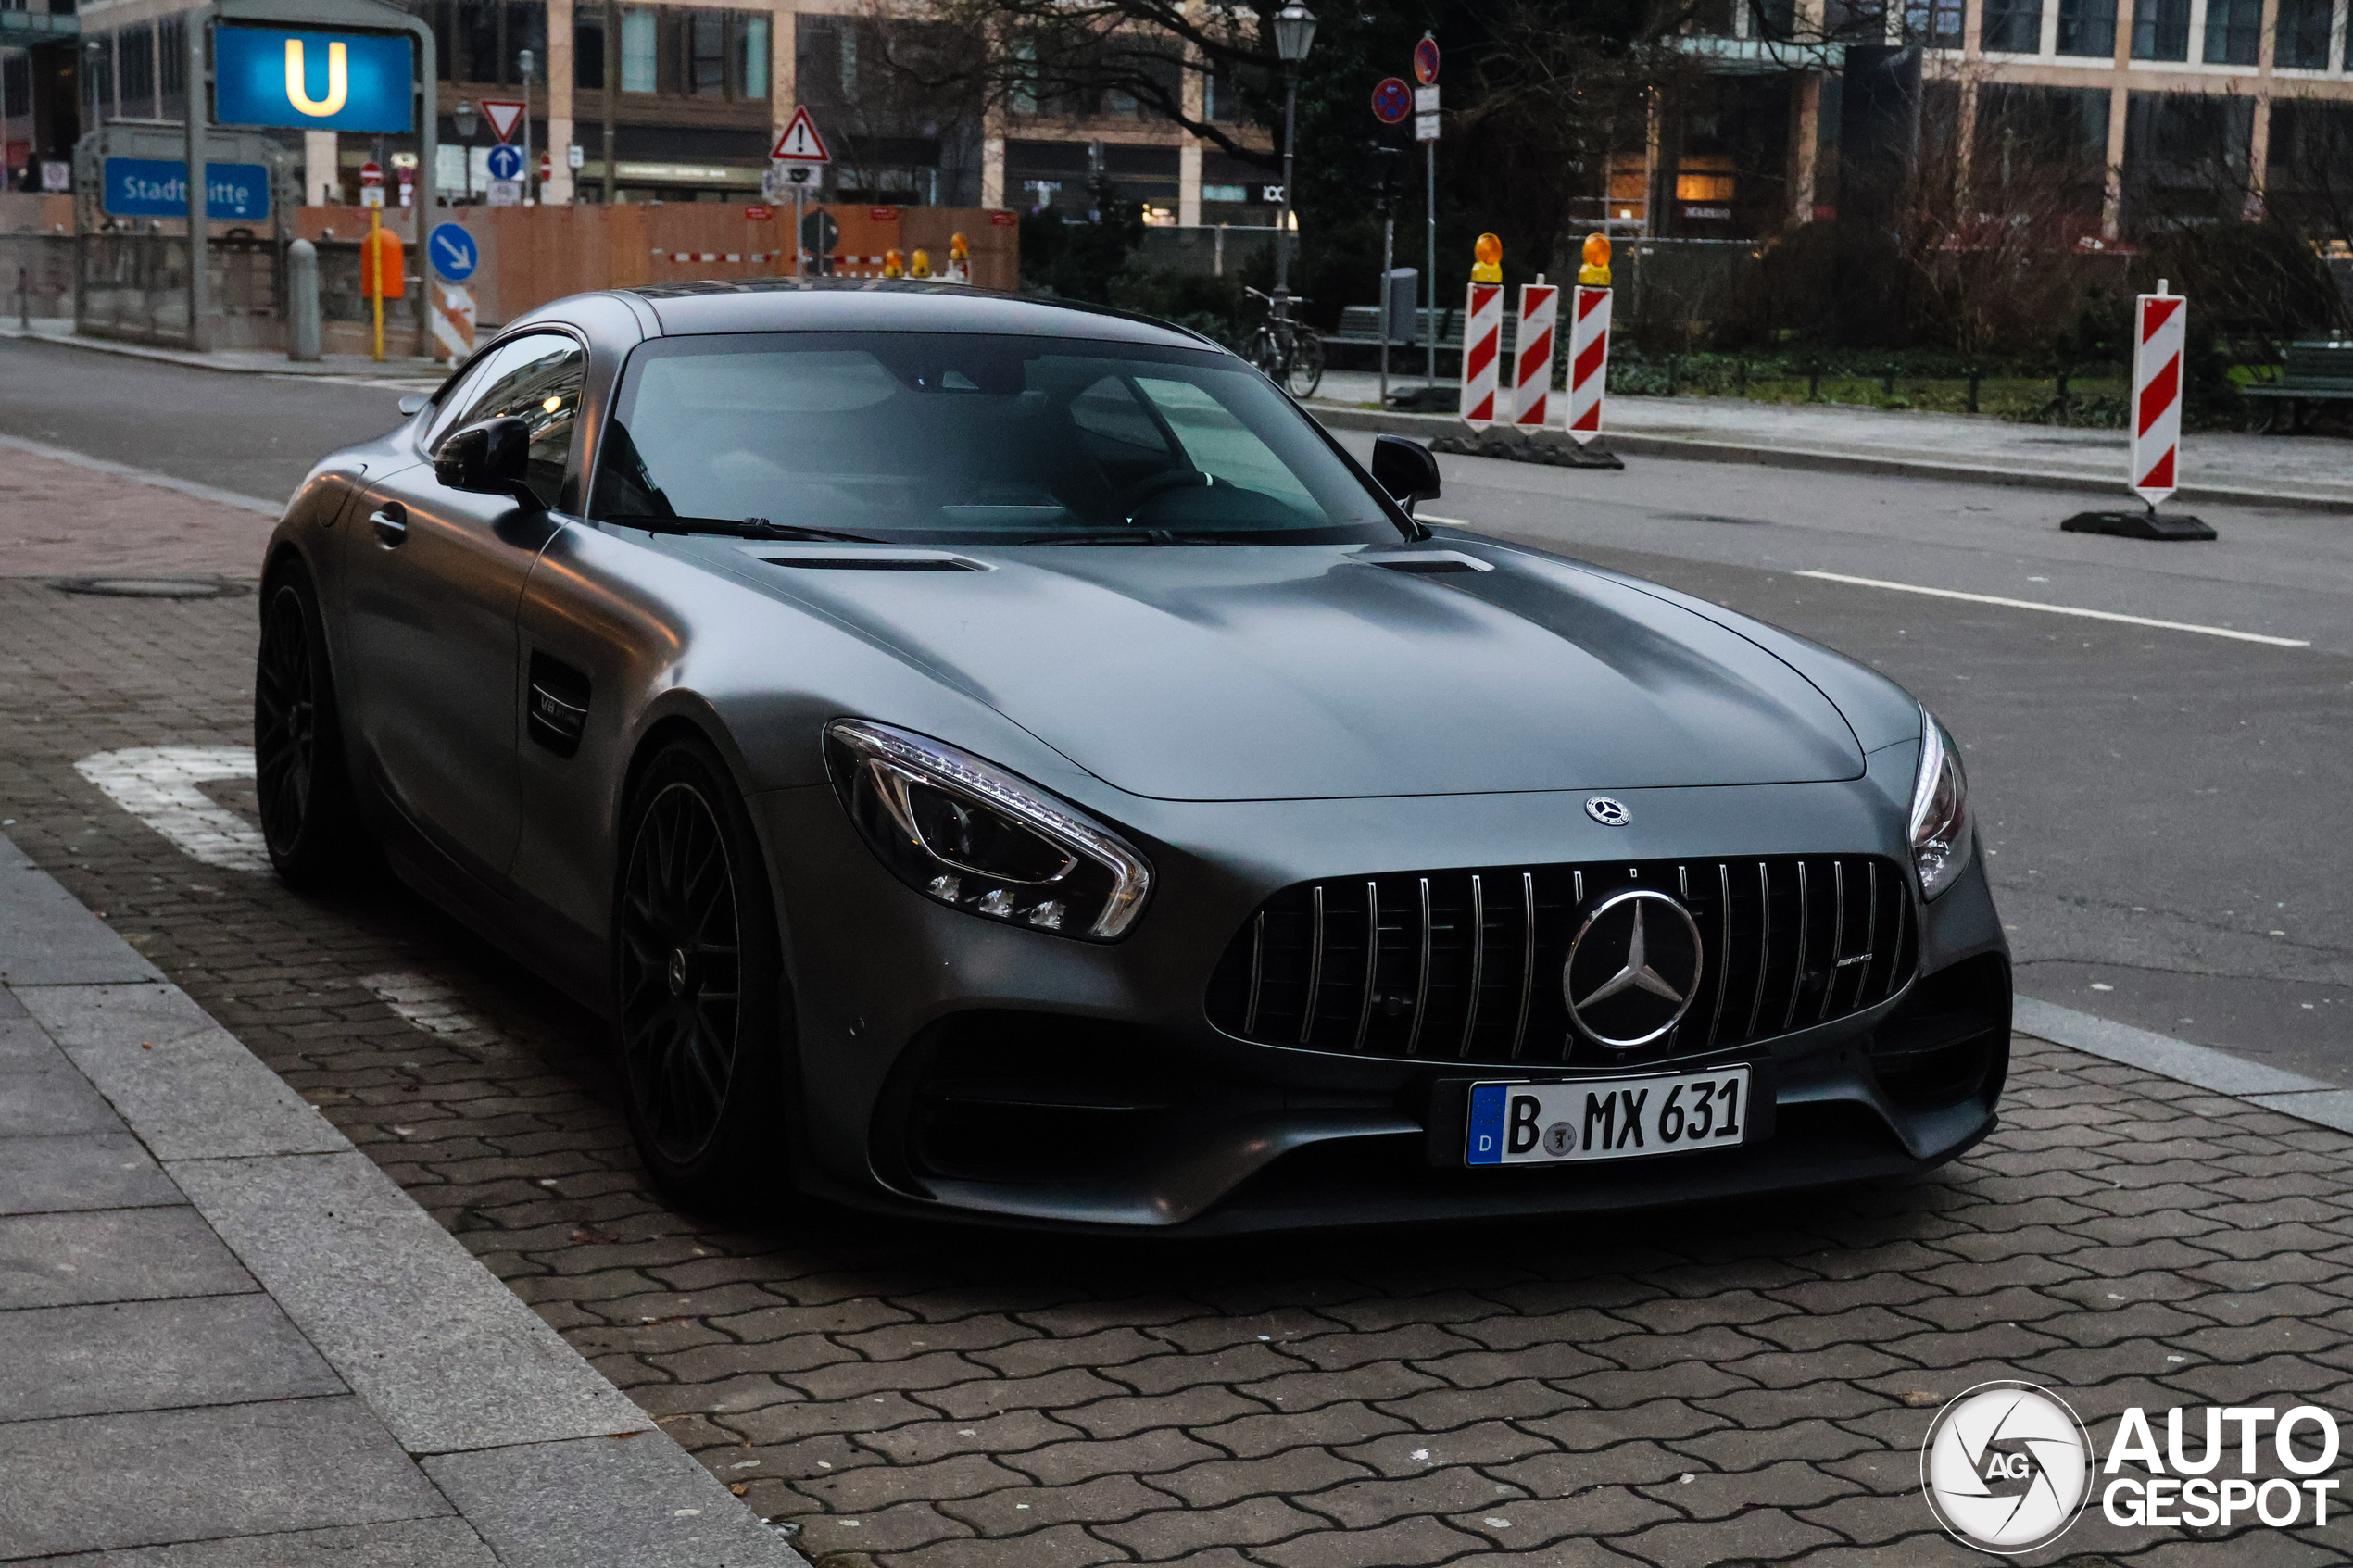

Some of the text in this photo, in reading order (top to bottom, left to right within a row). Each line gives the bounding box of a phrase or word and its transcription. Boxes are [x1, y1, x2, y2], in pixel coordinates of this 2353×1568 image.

[284, 39, 347, 117] U
[123, 176, 249, 205] Stadtitte
[1508, 1096, 1541, 1154] B
[1583, 1088, 1648, 1150] MX
[1659, 1078, 1739, 1143] 631
[1479, 1135, 1491, 1152] D
